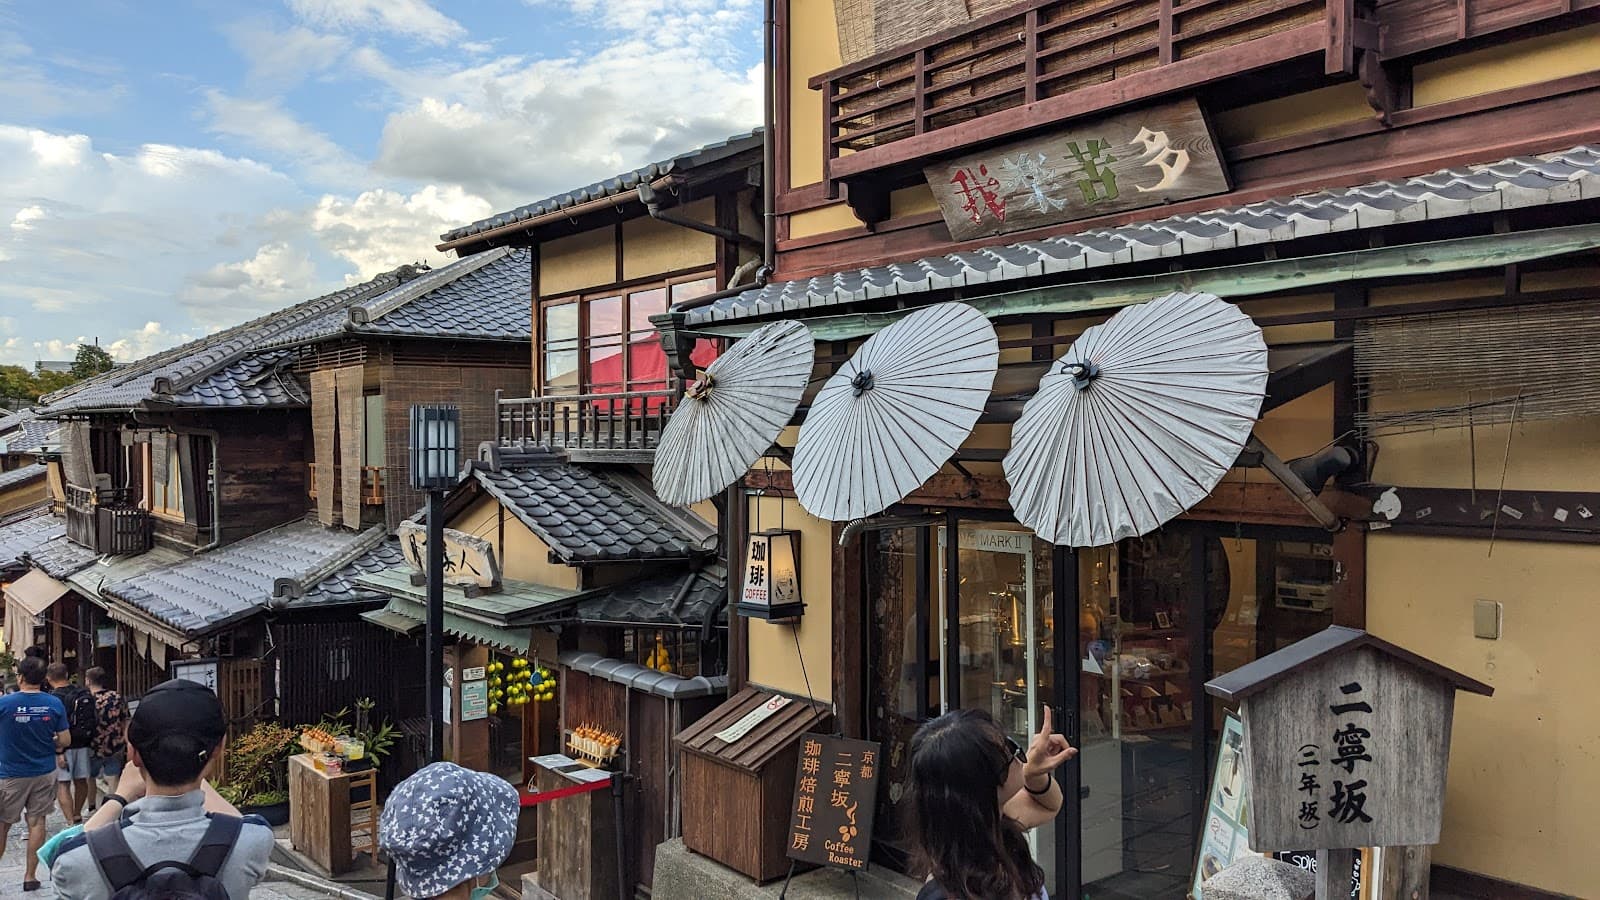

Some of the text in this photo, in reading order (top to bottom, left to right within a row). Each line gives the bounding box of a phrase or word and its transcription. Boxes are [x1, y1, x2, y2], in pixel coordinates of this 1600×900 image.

[980, 534, 1013, 549] MARK
[749, 540, 766, 587] 珈琲
[745, 588, 767, 601] COFFEE
[860, 750, 875, 779] 京都
[1328, 682, 1373, 823] 二寧坂
[792, 739, 822, 851] 珈琲焙煎工房
[831, 753, 852, 808] 二寧坂
[824, 840, 854, 854] Coffee
[829, 852, 863, 867] Roaster
